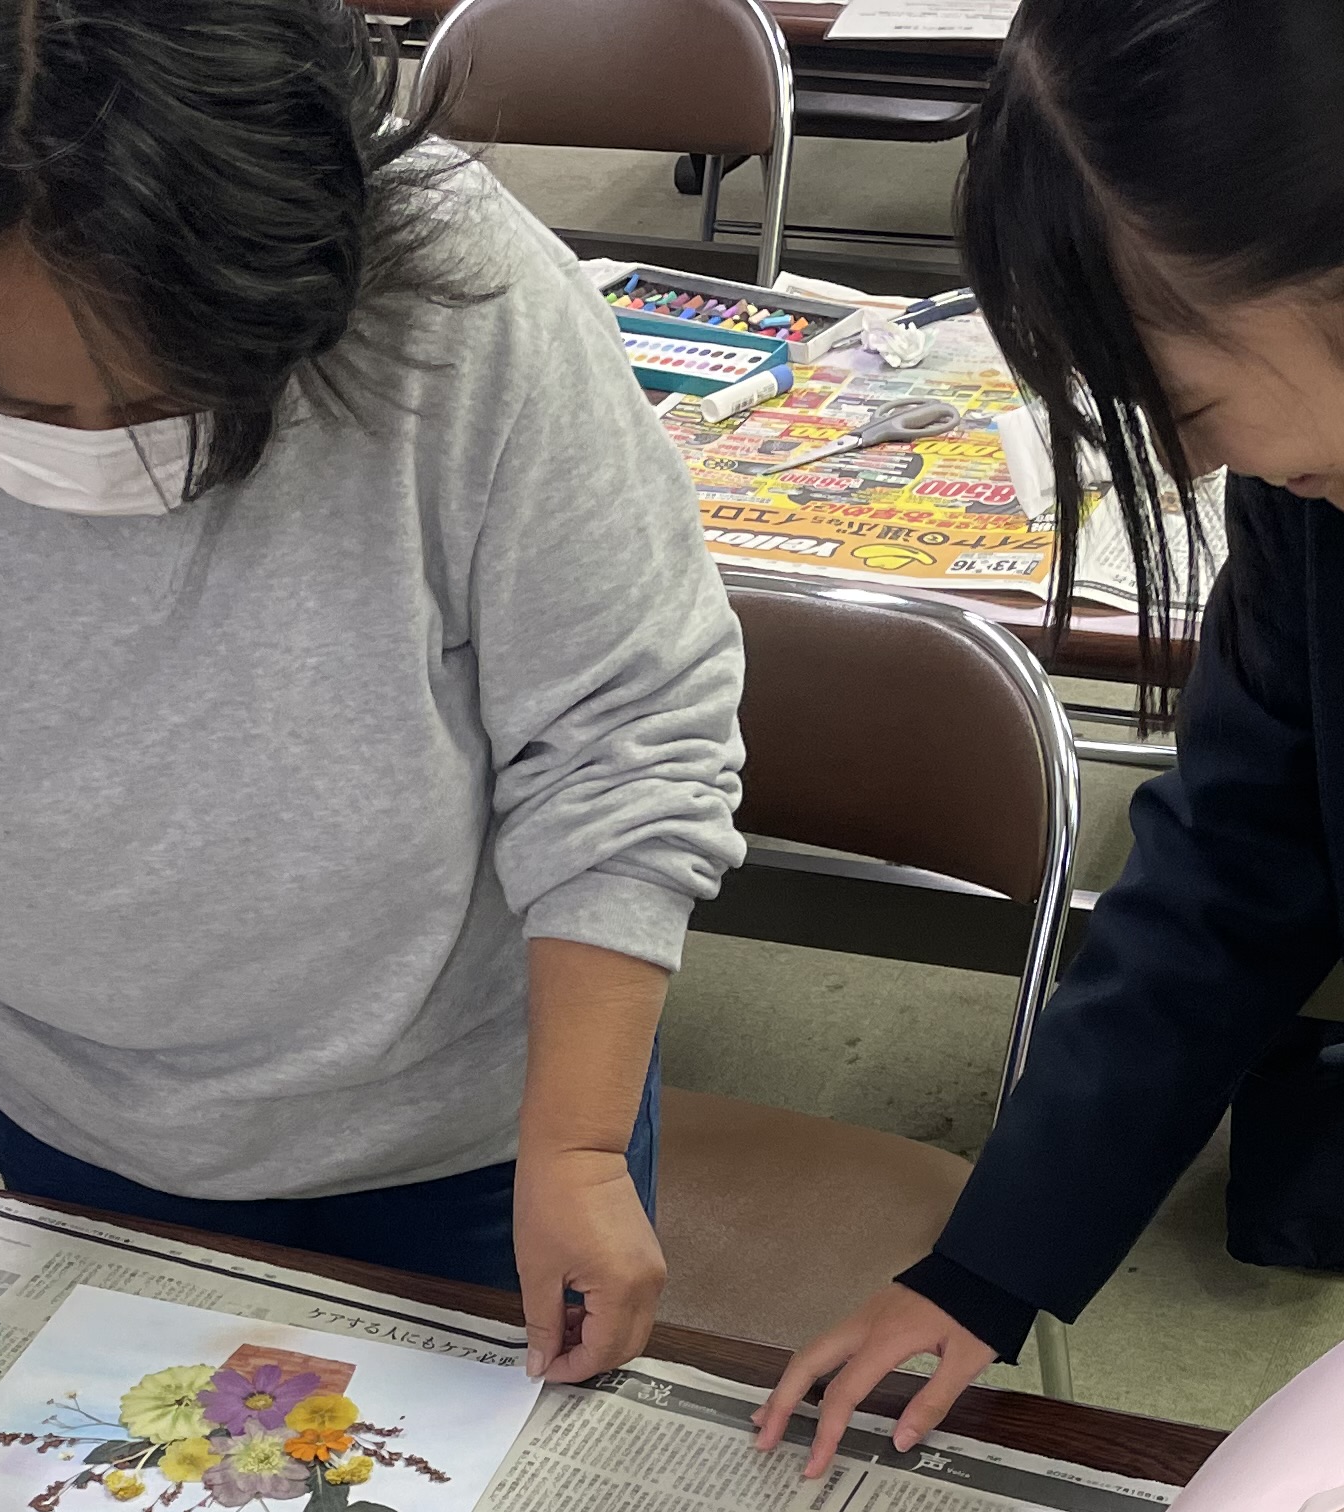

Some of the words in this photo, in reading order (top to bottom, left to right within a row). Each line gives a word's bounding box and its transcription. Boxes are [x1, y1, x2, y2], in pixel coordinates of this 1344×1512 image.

[916, 480, 1015, 506] 8500
[309, 1306, 520, 1368] ケアする人にもケア必要
[909, 1450, 952, 1474] 声
